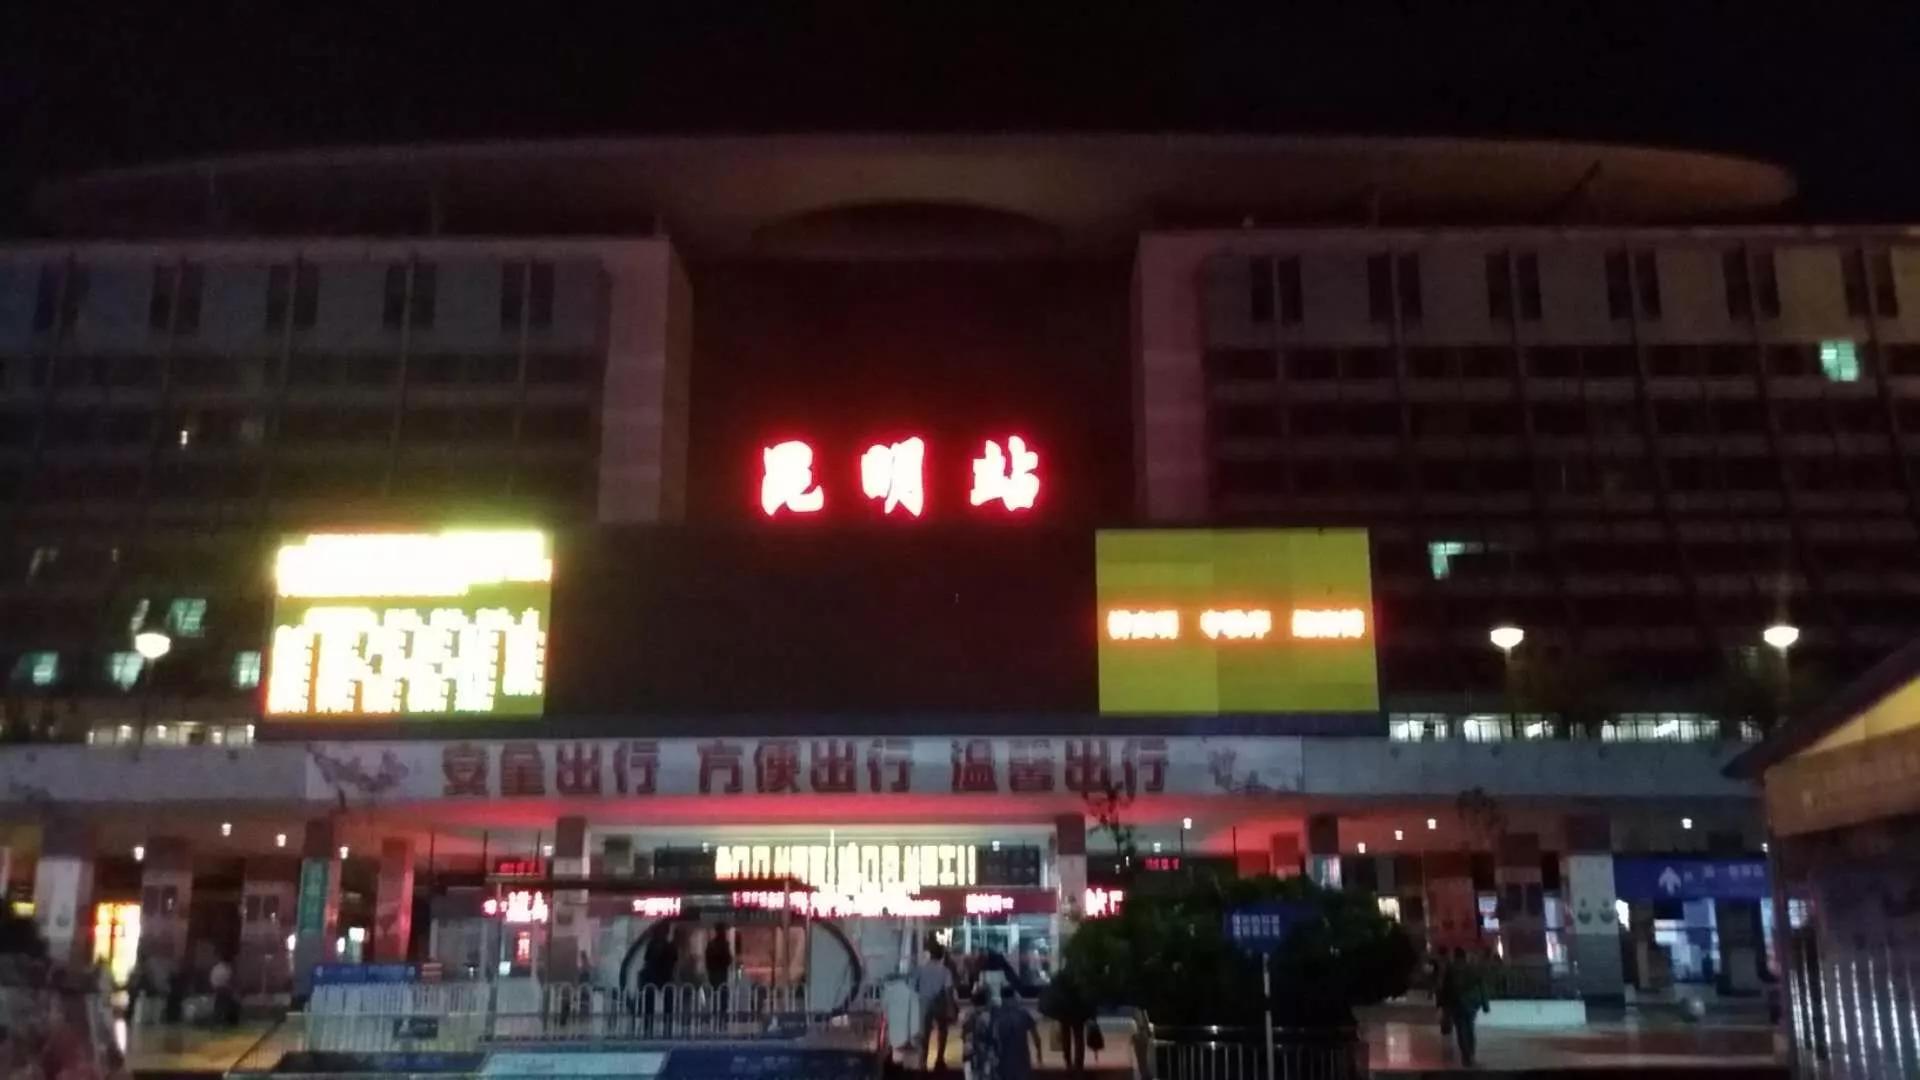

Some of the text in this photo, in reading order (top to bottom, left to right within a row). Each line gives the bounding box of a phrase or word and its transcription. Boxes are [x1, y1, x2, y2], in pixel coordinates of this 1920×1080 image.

[761, 435, 1040, 517] 昆明站
[441, 738, 1169, 796] 安全出行 方便出行 温馨出行
